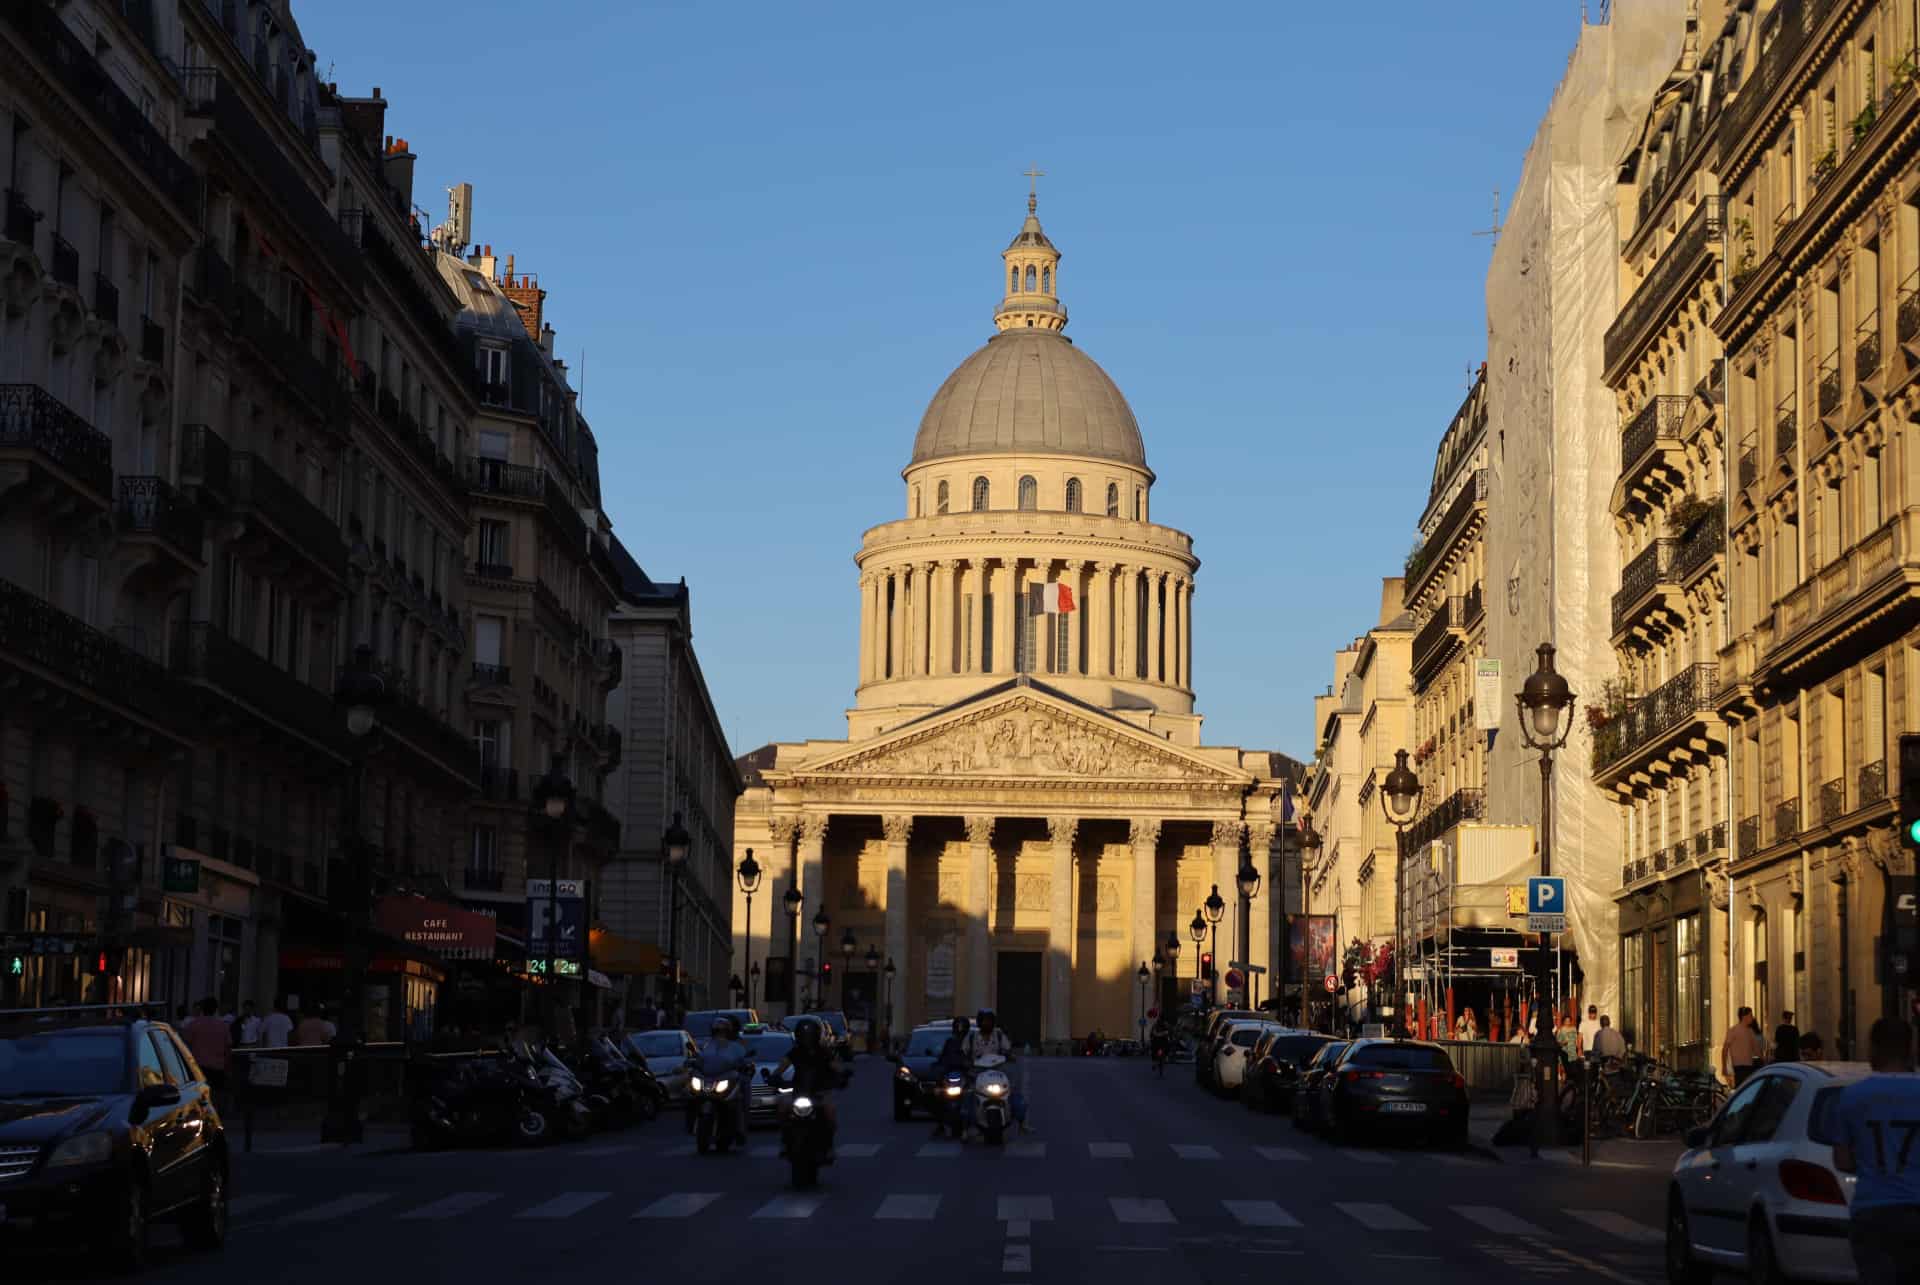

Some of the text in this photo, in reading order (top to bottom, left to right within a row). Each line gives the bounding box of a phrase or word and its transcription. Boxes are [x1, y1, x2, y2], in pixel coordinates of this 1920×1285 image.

[1537, 883, 1555, 908] P
[531, 900, 563, 939] P
[403, 931, 464, 941] RESTAURANT
